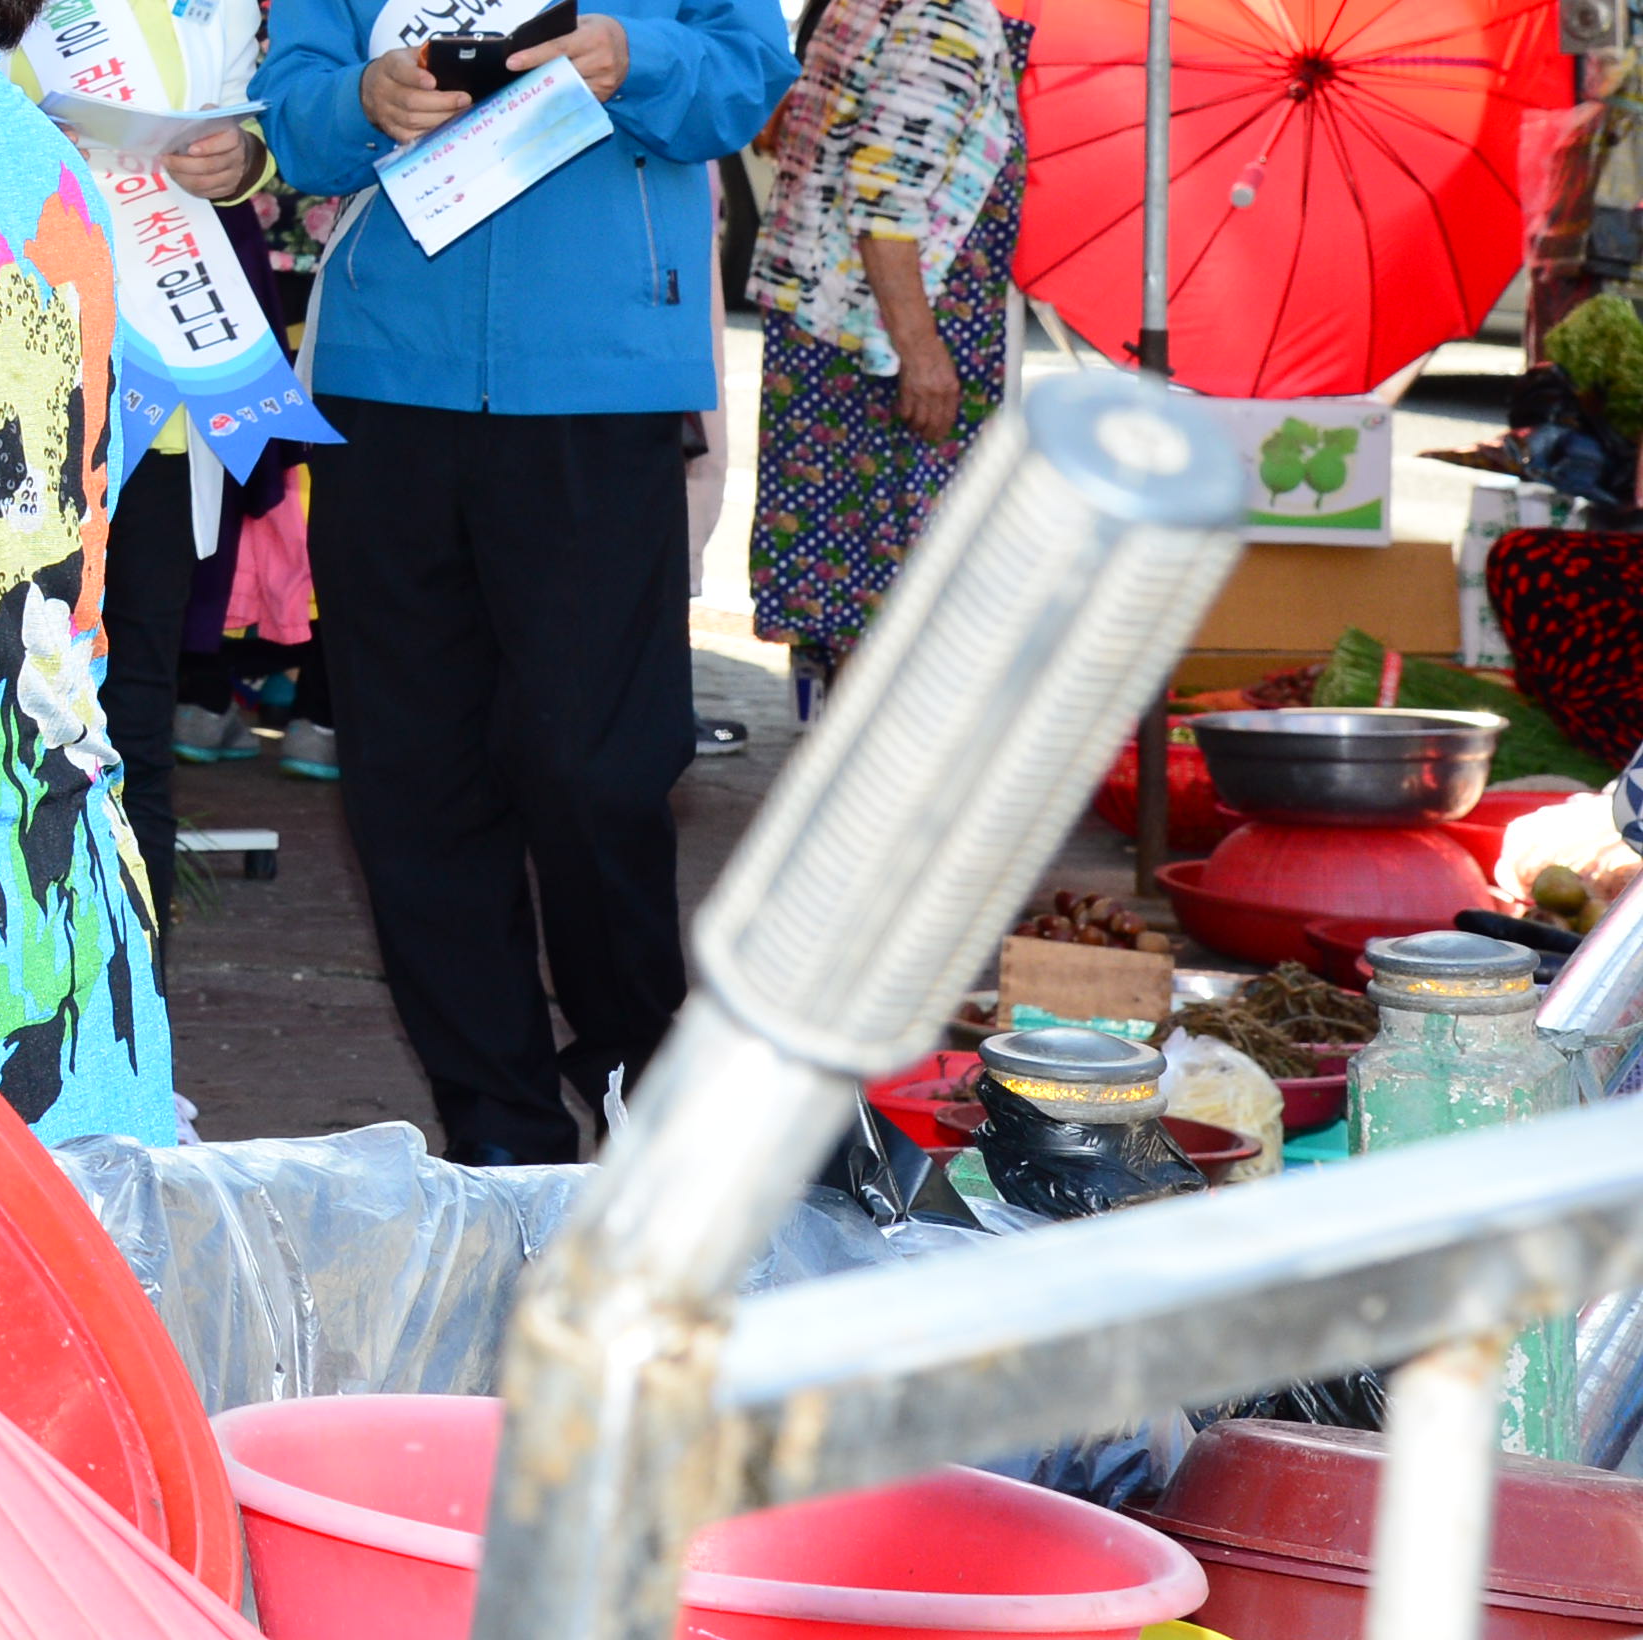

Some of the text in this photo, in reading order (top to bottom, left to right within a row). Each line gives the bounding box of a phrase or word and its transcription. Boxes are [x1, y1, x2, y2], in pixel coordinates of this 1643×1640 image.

[134, 206, 239, 351] 초석입니다
[123, 389, 163, 426] 제시
[236, 389, 303, 423] 거제시
